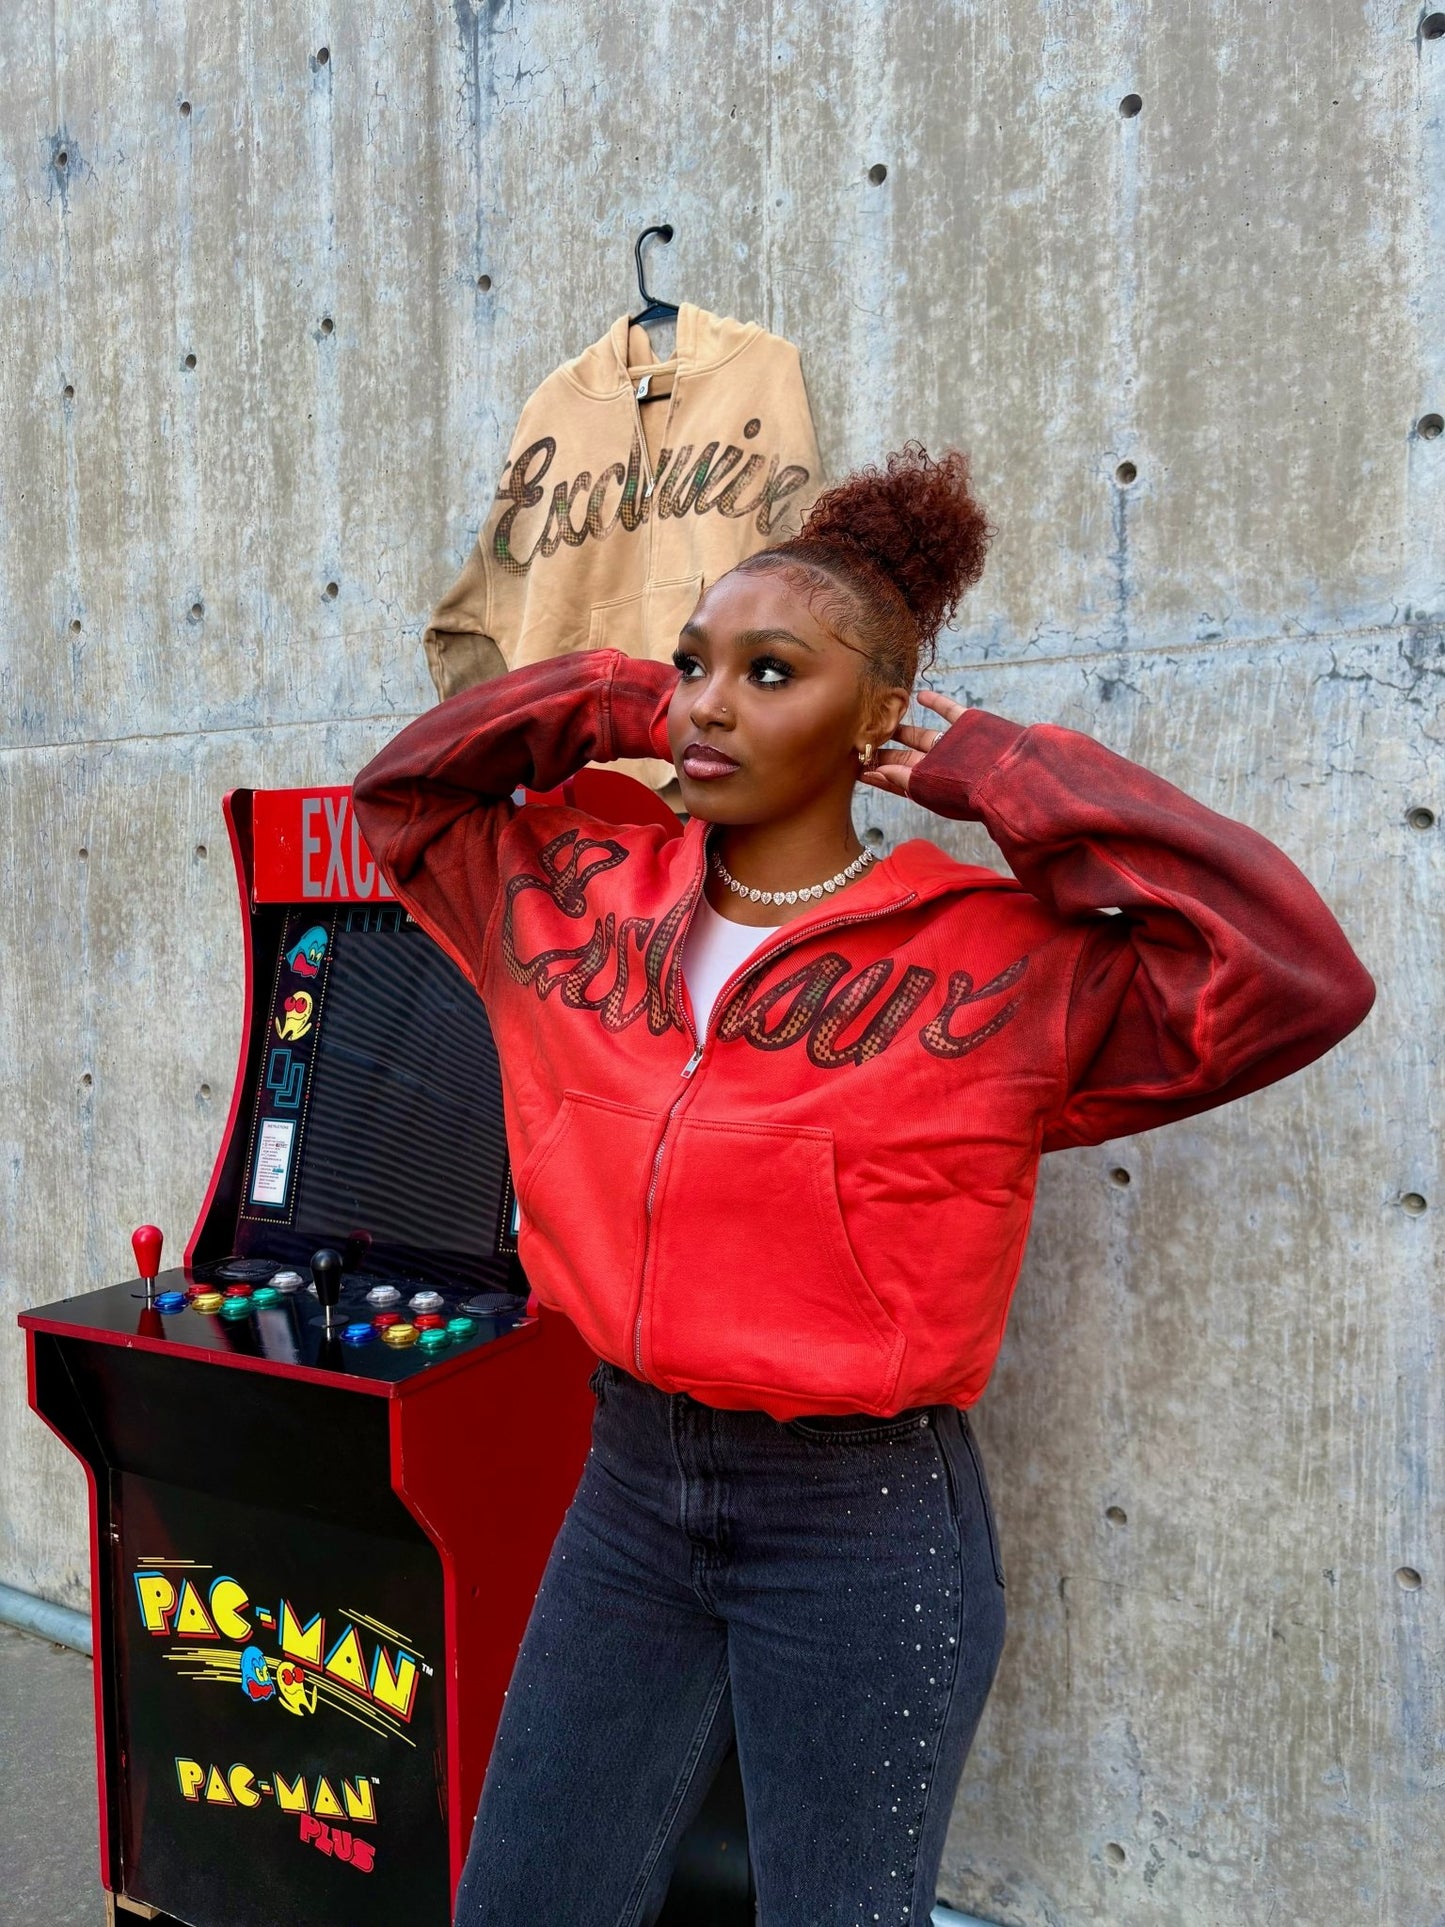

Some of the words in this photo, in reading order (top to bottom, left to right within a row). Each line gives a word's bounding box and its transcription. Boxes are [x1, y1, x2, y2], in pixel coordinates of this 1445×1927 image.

[133, 1571, 419, 1724] PAC-MAN
[175, 1756, 378, 1824] PAC-MAN
[300, 1812, 376, 1873] PLUS
